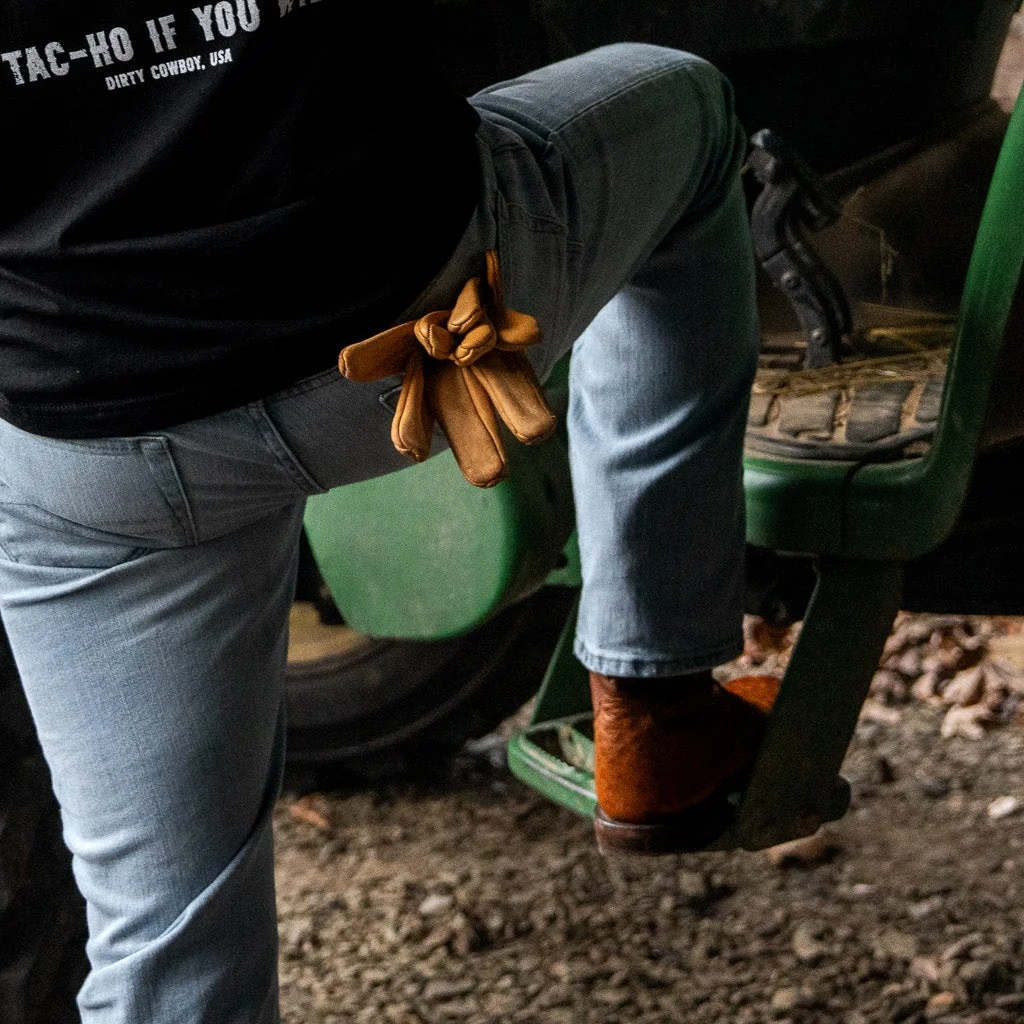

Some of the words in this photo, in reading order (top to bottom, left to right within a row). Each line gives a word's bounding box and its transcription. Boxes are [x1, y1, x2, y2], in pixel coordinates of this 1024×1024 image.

[1, 26, 135, 86] TAC-HO
[146, 14, 178, 54] IF
[105, 68, 146, 91] DIRTY
[150, 55, 206, 81] COWBOY,
[209, 48, 234, 67] USA
